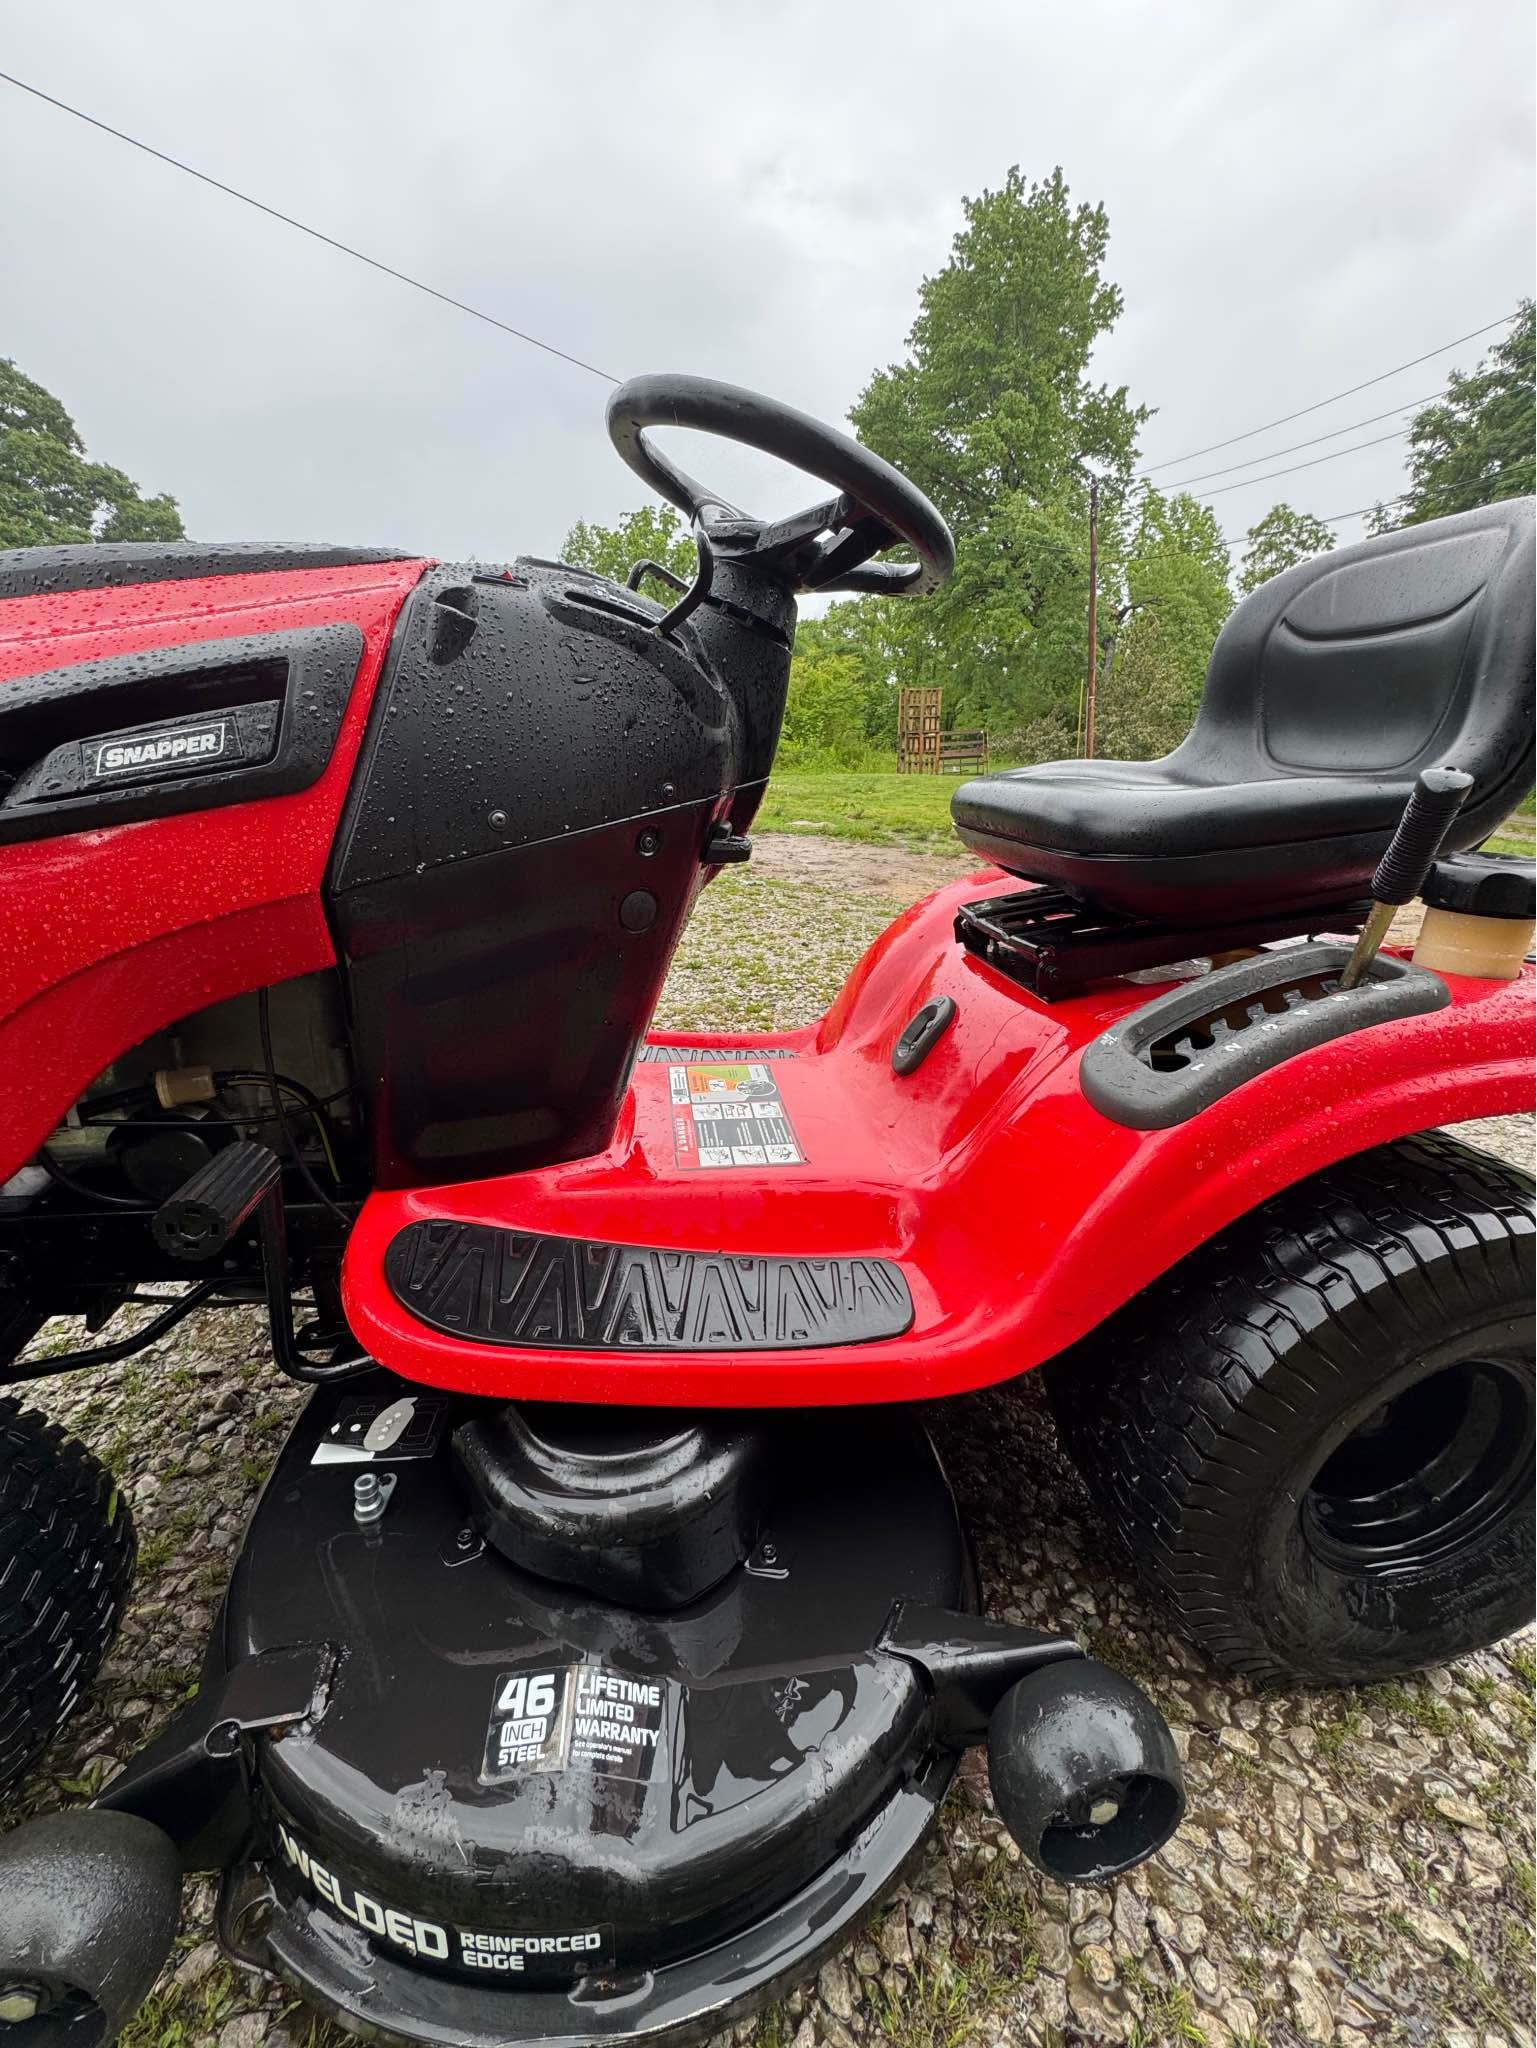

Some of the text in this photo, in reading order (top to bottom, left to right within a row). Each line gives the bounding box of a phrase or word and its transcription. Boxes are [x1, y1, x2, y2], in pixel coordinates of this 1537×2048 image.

[105, 733, 217, 768] SNAPPER
[1223, 1042, 1243, 1052] 2
[1260, 1022, 1279, 1032] 3
[676, 1117, 689, 1145] DANGER
[497, 1673, 556, 1720] 46
[578, 1674, 660, 1708] LIFETIME
[575, 1694, 635, 1723] LIMITED
[503, 1719, 544, 1743] INCH
[574, 1717, 660, 1748] WARRANTY
[497, 1743, 546, 1767] STEEL
[278, 1824, 449, 1960] WELDED
[459, 1932, 601, 1954] REINFORCED
[462, 1950, 525, 1972] EDGE
